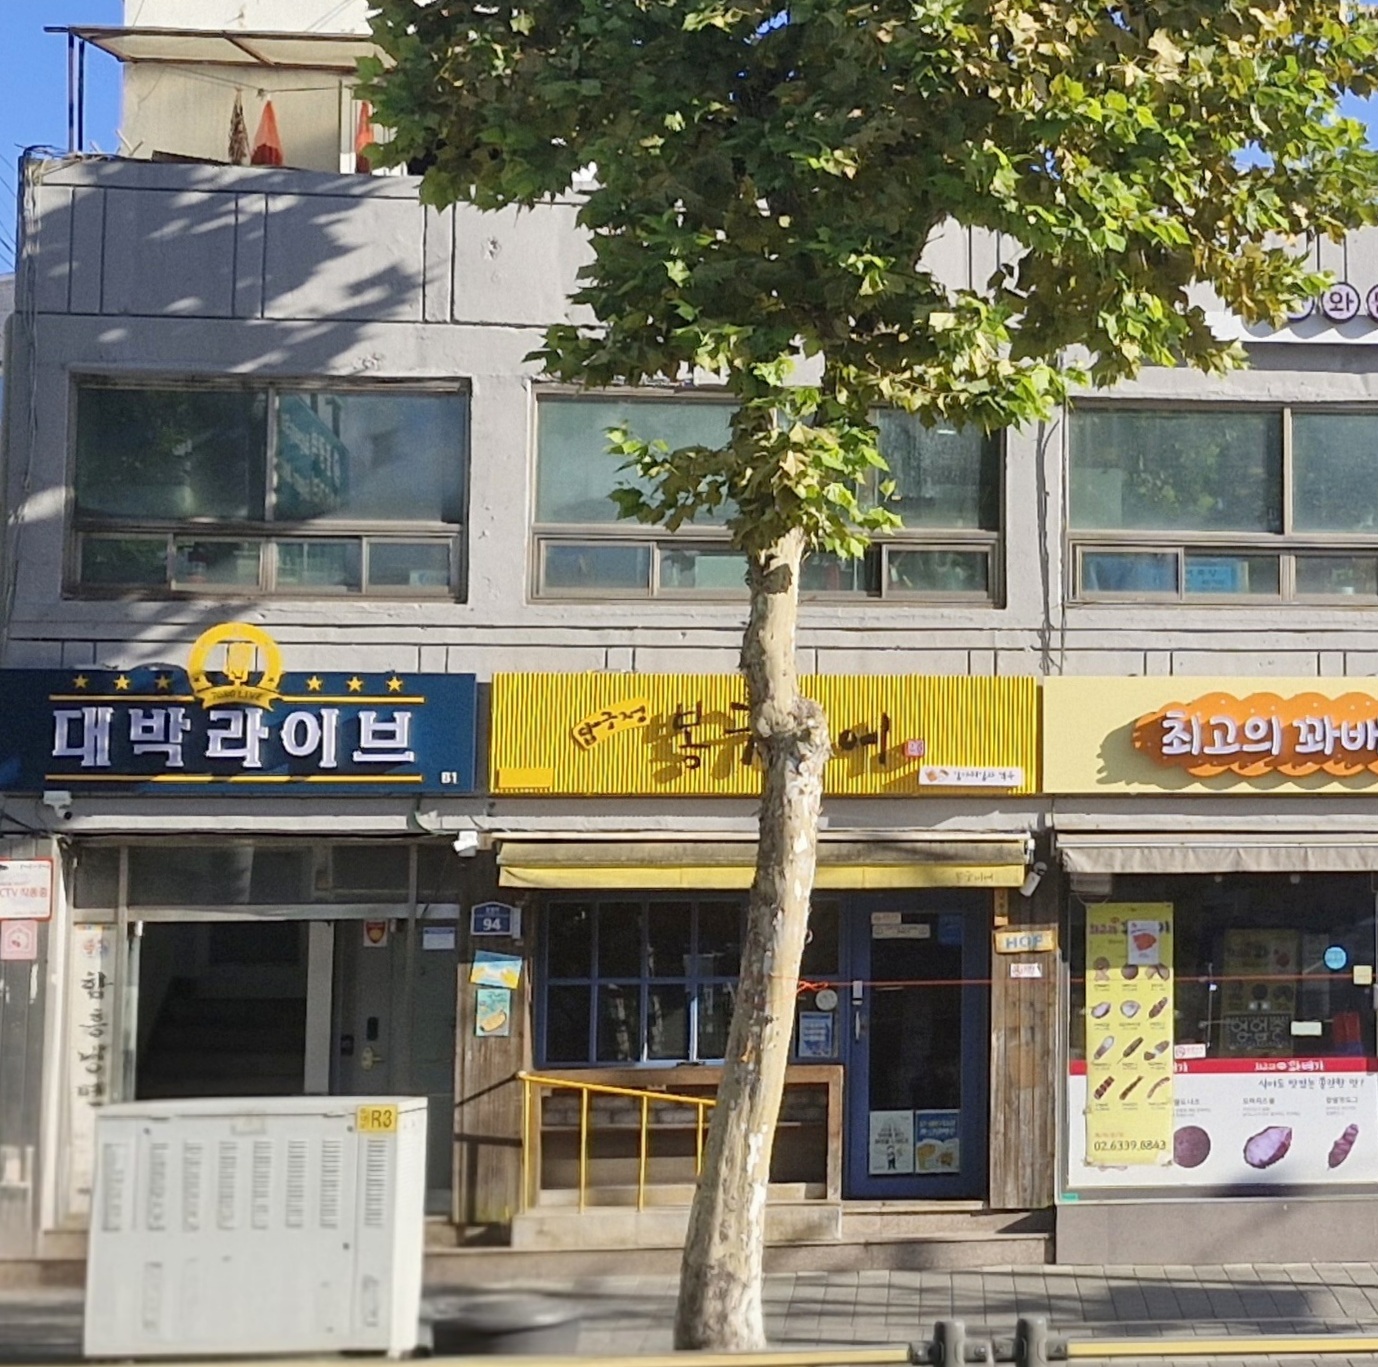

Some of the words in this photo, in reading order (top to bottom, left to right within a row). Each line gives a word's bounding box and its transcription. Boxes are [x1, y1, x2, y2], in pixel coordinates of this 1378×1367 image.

[52, 705, 415, 768] 대박라이브
[1161, 711, 1284, 756] 최고의
[440, 771, 459, 785] B1
[483, 918, 501, 931] 94
[1005, 935, 1044, 950] HOF
[371, 1109, 392, 1128] R3
